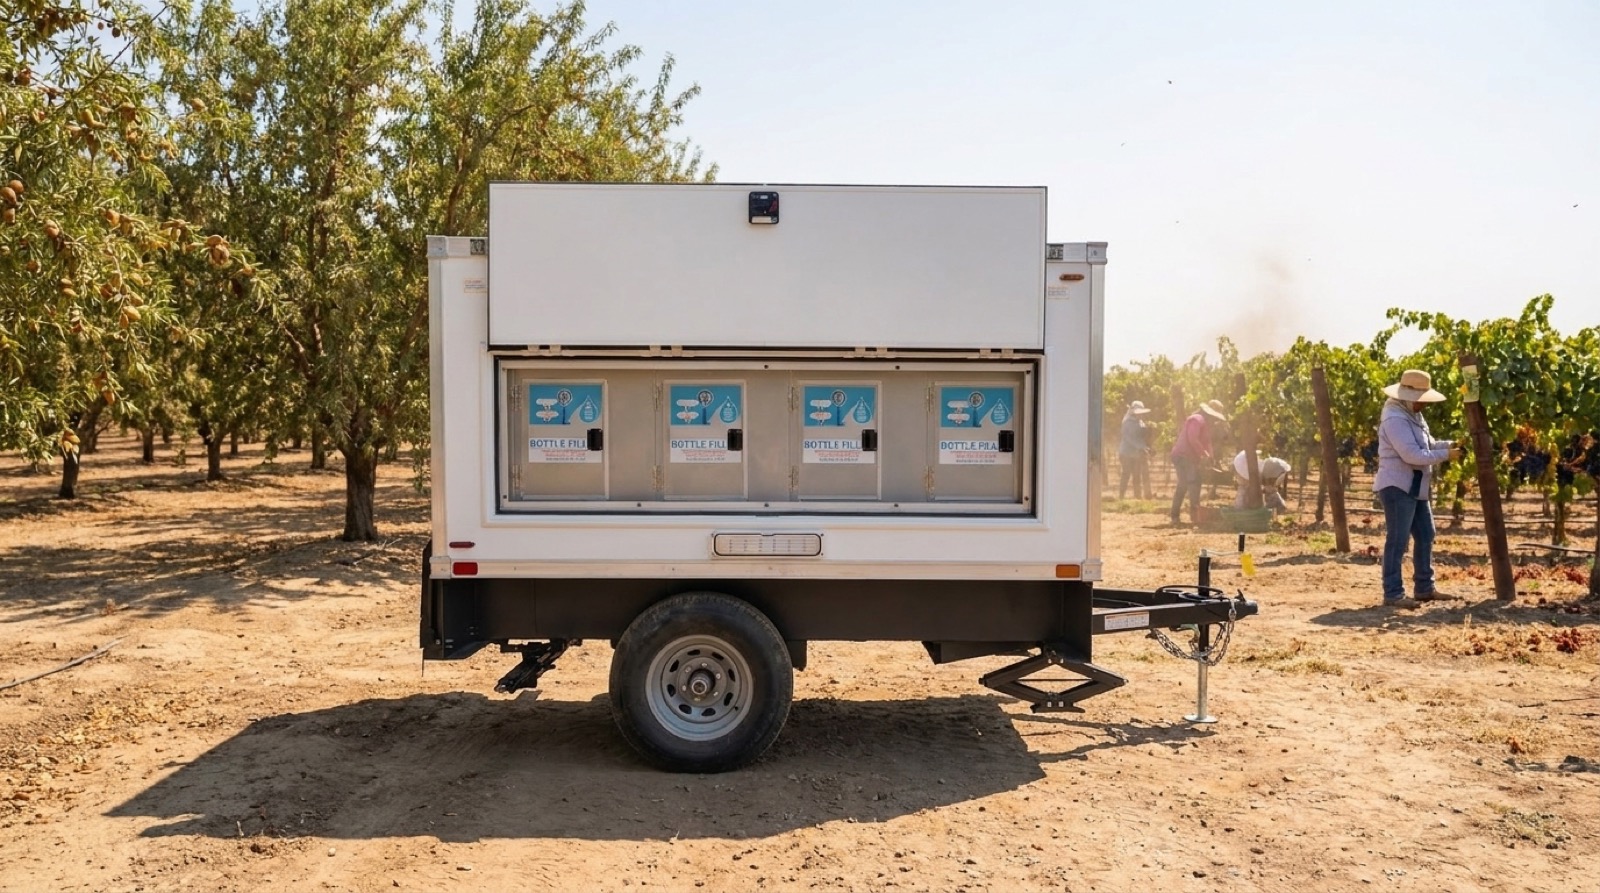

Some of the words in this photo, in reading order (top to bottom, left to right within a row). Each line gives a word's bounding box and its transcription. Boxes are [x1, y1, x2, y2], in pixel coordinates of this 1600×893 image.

[530, 440, 565, 448] BOTTLE
[671, 440, 706, 449] BOTTLE
[804, 440, 839, 449] BOTTLE
[842, 441, 862, 449] FILL
[941, 441, 977, 450] BOTTLE
